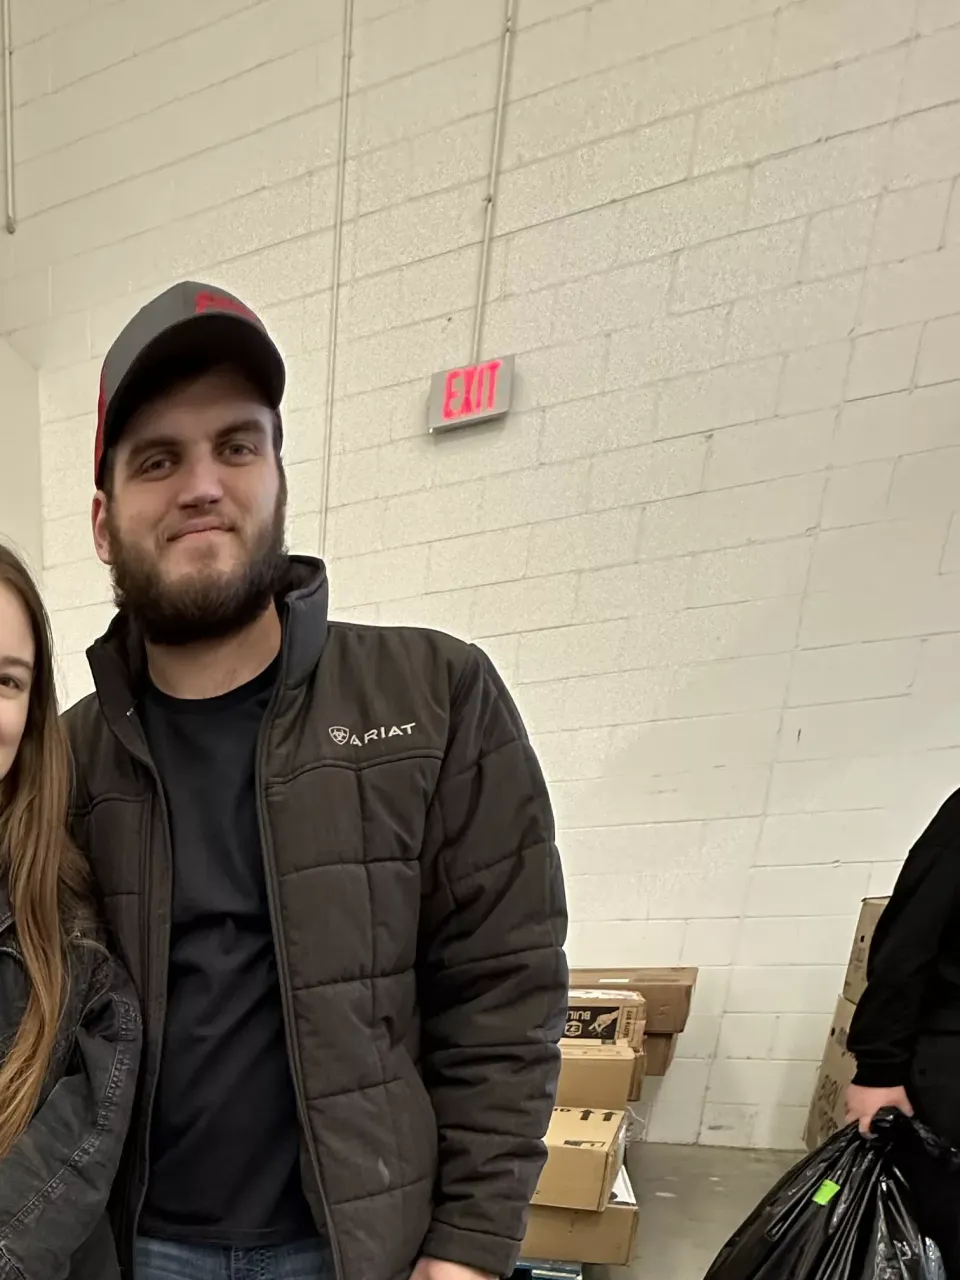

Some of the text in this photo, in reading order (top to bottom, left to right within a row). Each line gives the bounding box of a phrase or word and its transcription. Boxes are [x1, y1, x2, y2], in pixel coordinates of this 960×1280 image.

[442, 359, 504, 420] EXIT
[350, 722, 416, 747] ARIAT
[566, 1010, 591, 1020] BUIL
